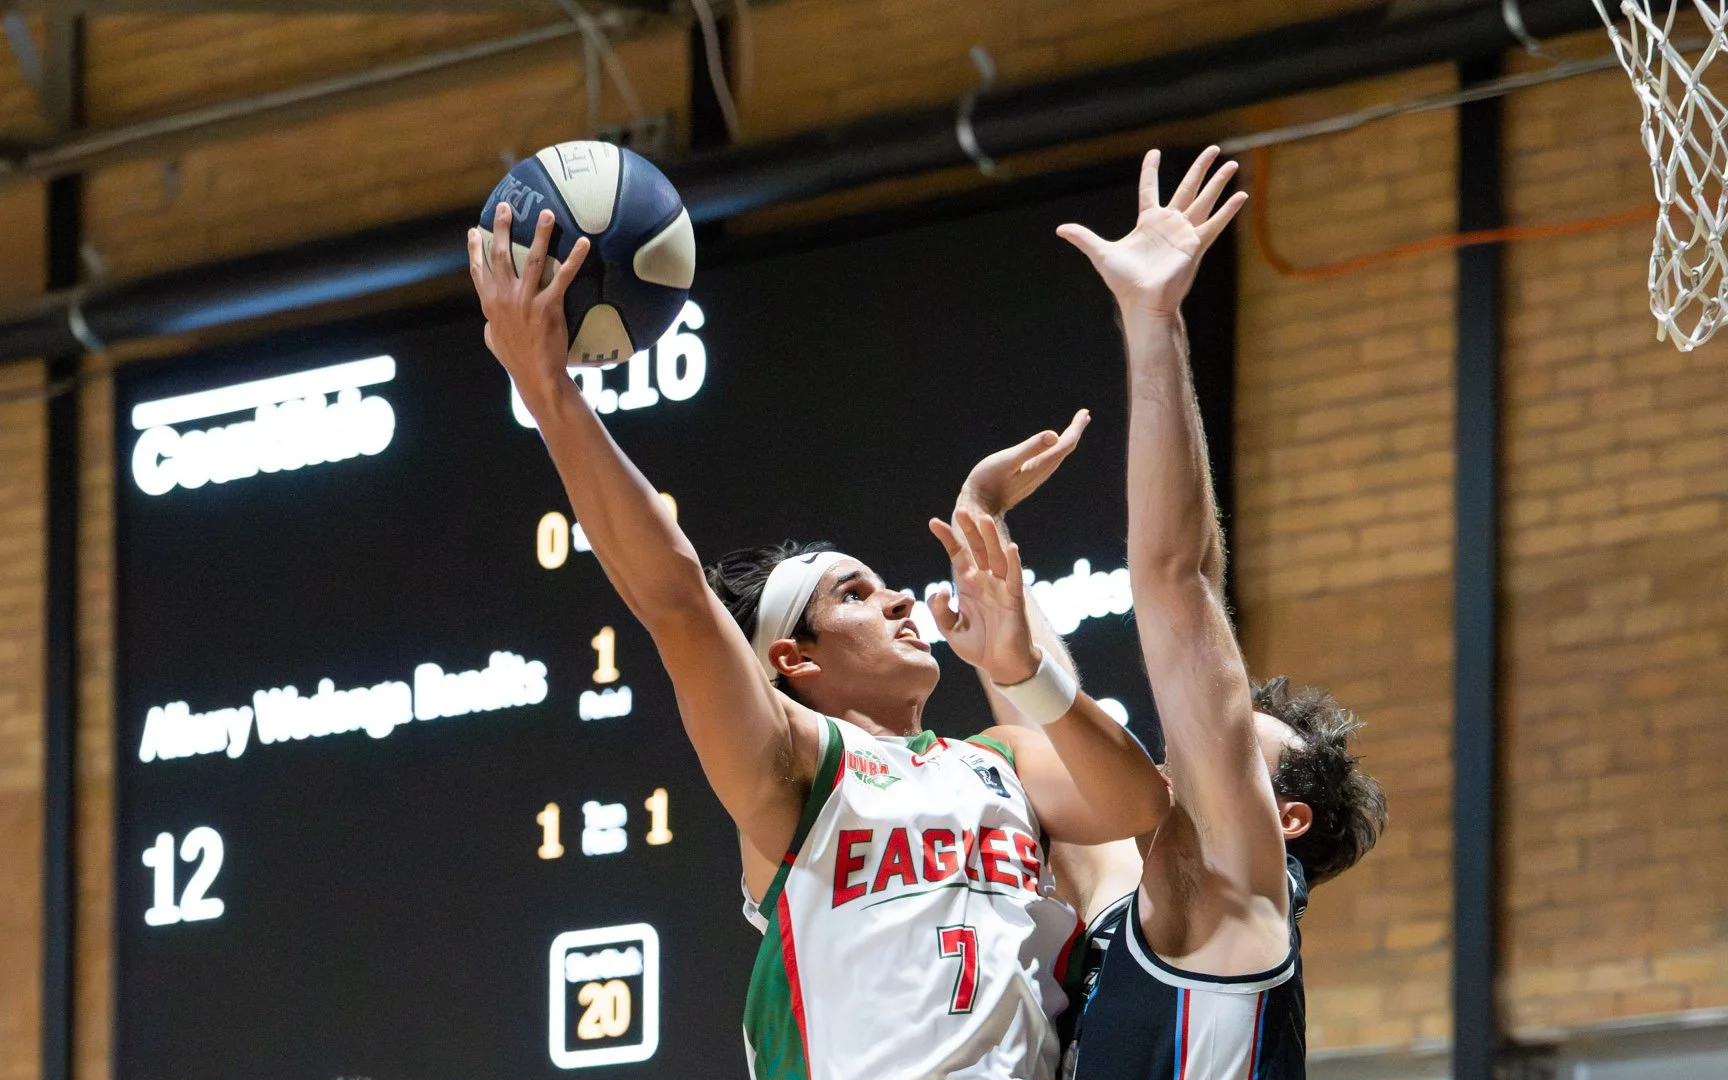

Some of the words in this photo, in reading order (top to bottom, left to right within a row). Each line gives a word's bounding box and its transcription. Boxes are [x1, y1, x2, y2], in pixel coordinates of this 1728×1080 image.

[537, 512, 568, 568] 0
[592, 627, 619, 683] 1
[537, 803, 564, 860] 1
[644, 789, 672, 845] 1
[142, 826, 224, 927] 12
[831, 826, 1041, 910] EAGLES
[936, 924, 980, 1015] 7
[577, 979, 631, 1040] 20
